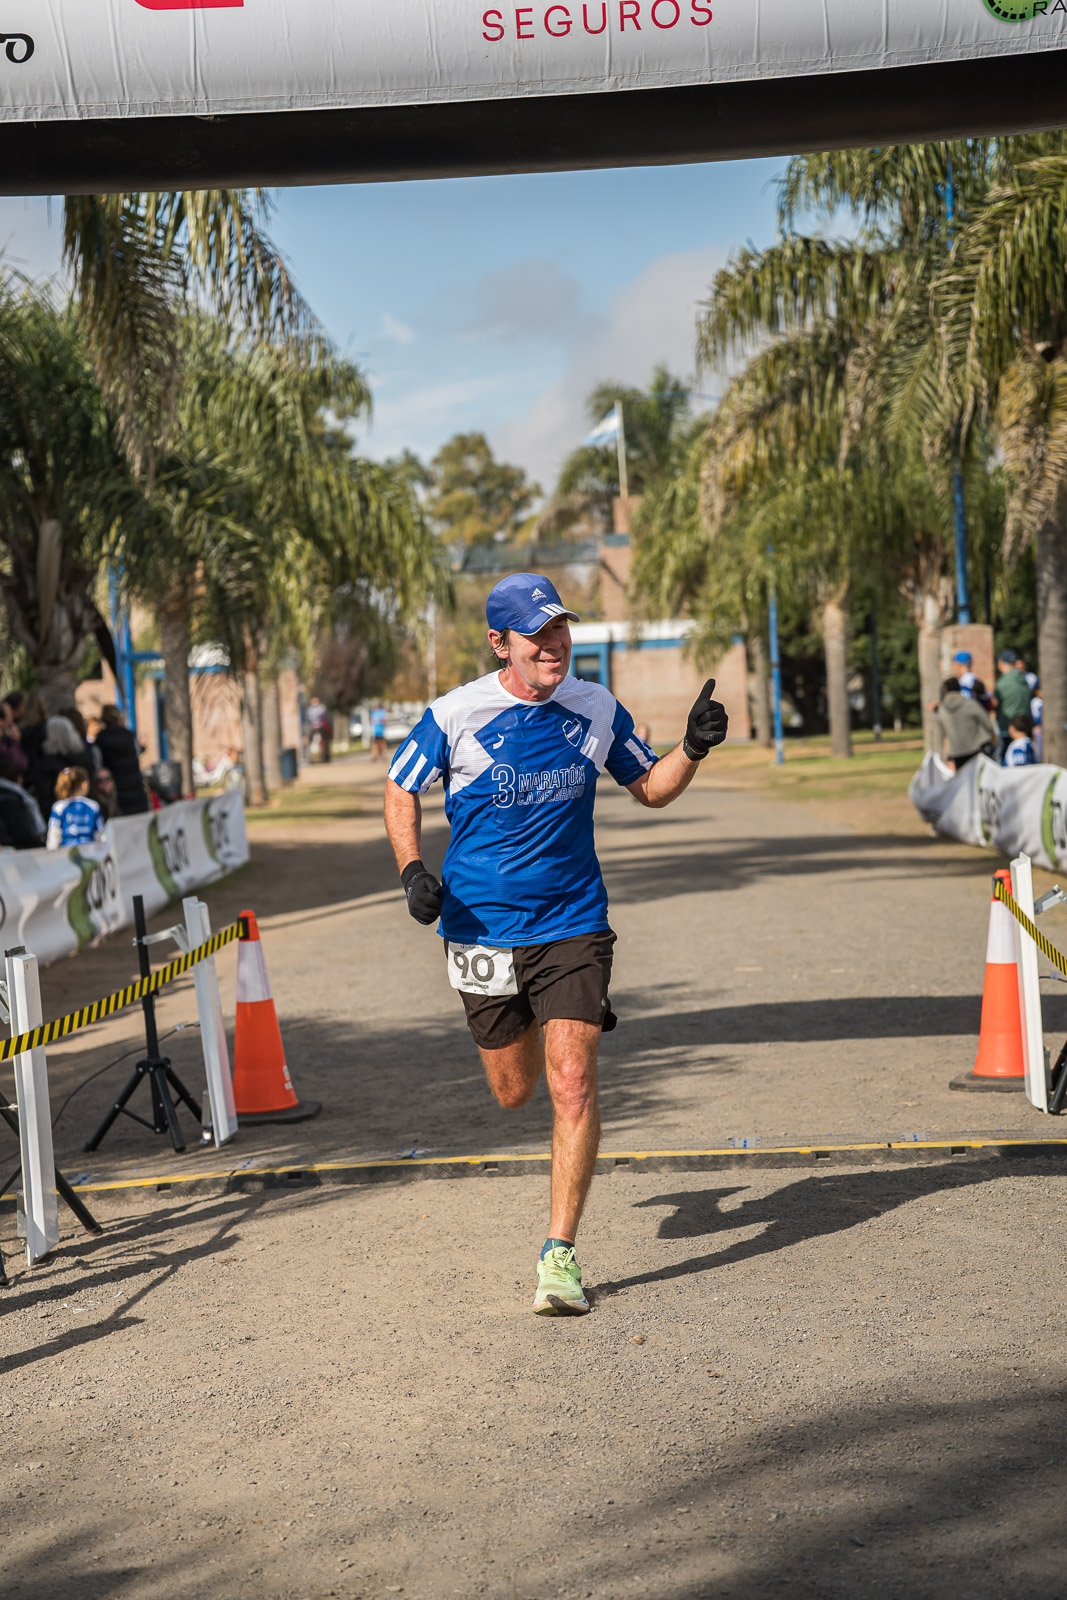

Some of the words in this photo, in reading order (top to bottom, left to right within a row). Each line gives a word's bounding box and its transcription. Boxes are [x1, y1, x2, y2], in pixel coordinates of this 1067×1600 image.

[482, 0, 713, 42] SEGUROS
[491, 763, 516, 809] 3
[518, 763, 586, 793] MARATÓN
[453, 951, 495, 983] 90
